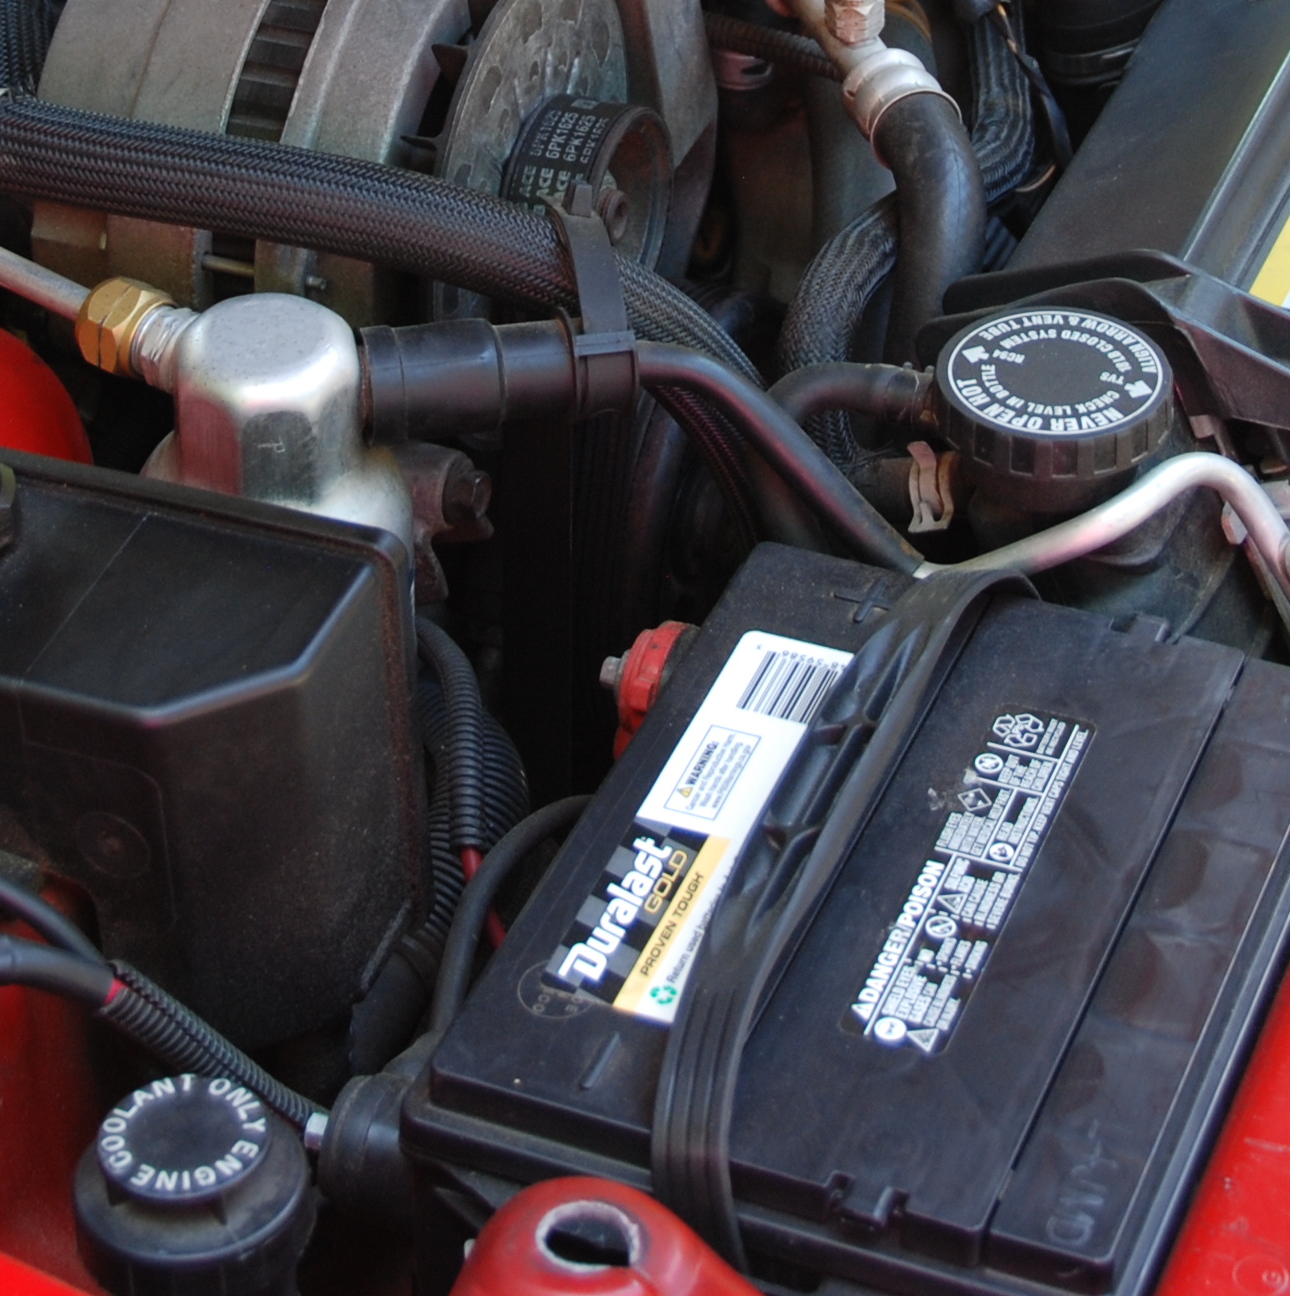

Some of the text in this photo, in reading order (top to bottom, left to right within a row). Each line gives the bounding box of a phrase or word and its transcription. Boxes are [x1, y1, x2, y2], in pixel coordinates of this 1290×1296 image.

[545, 111, 579, 159] 6PK1625
[562, 114, 596, 162] 6PK1625
[976, 312, 1157, 374] ALIGN ARROW & VENT TUBE
[990, 347, 1025, 364] RC94
[998, 327, 1057, 349] SYSTEM
[1061, 328, 1110, 353] CLOSED
[954, 376, 1124, 432] NEVER OPEN HOT
[978, 362, 1120, 415] CHECK LEVEL IN BOTTLE
[1098, 370, 1124, 385] TVS
[685, 741, 718, 784] WARNING:
[642, 849, 689, 913] GOLD
[559, 837, 672, 985] Duralast
[639, 873, 703, 975] PROVEN TOUGH
[859, 861, 944, 1001] DANGER/POISON
[665, 952, 690, 983] Return
[682, 930, 702, 952] used
[100, 1071, 266, 1191] ENGINE COOLANT ONLY
